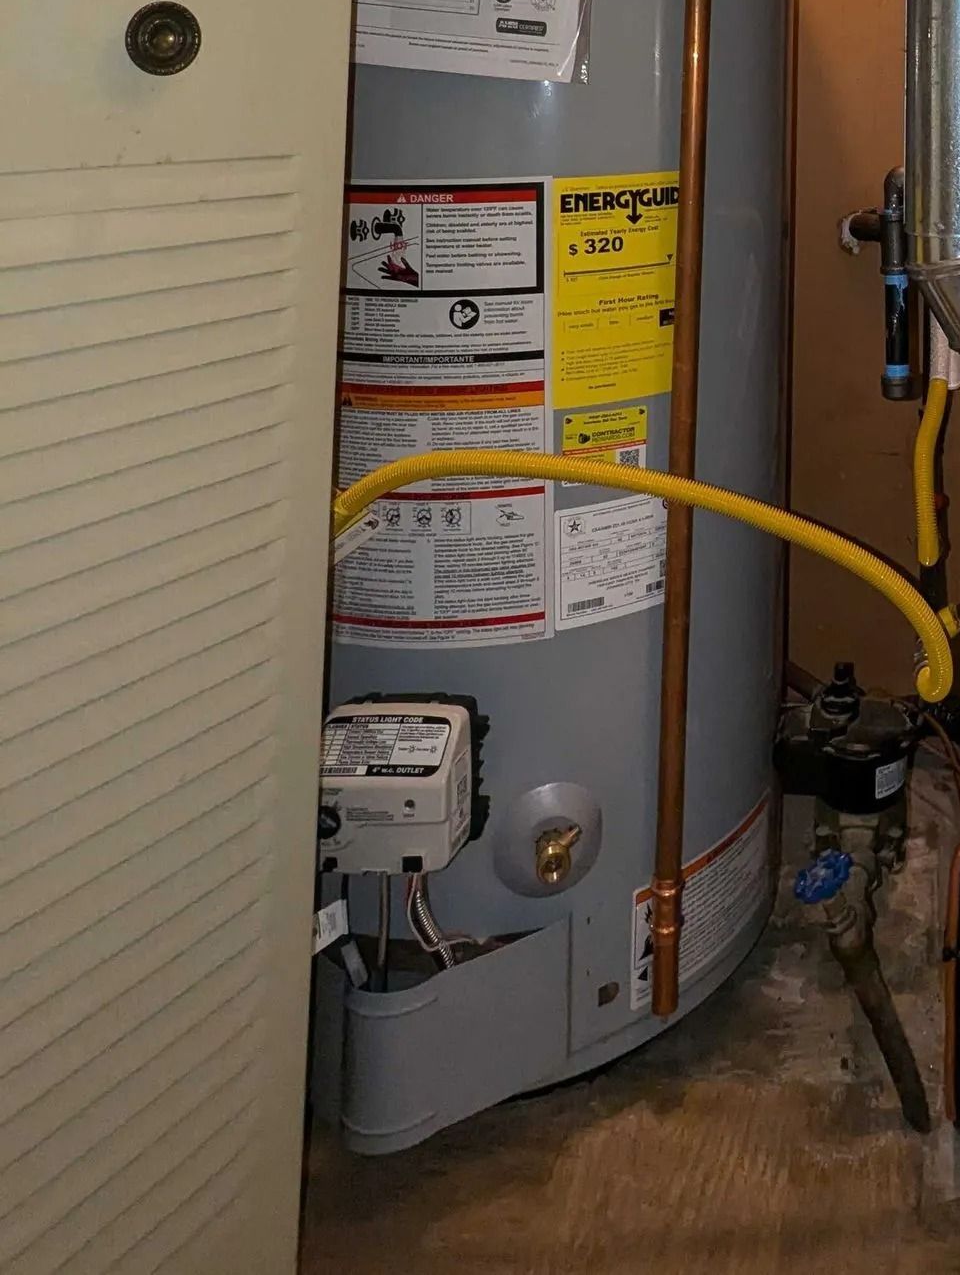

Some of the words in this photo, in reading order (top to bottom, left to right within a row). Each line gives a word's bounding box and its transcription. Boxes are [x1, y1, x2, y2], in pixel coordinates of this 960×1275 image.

[410, 194, 453, 203] DANGER
[561, 186, 679, 213] ENERGYGUID
[610, 228, 627, 236] Yearly
[628, 226, 646, 234] Energy
[569, 243, 578, 256] $
[584, 236, 624, 254] 320
[637, 294, 659, 302] Rating
[383, 355, 474, 363] IMPORTANT/IMPORTANTE
[592, 427, 635, 437] CONTRACTOR
